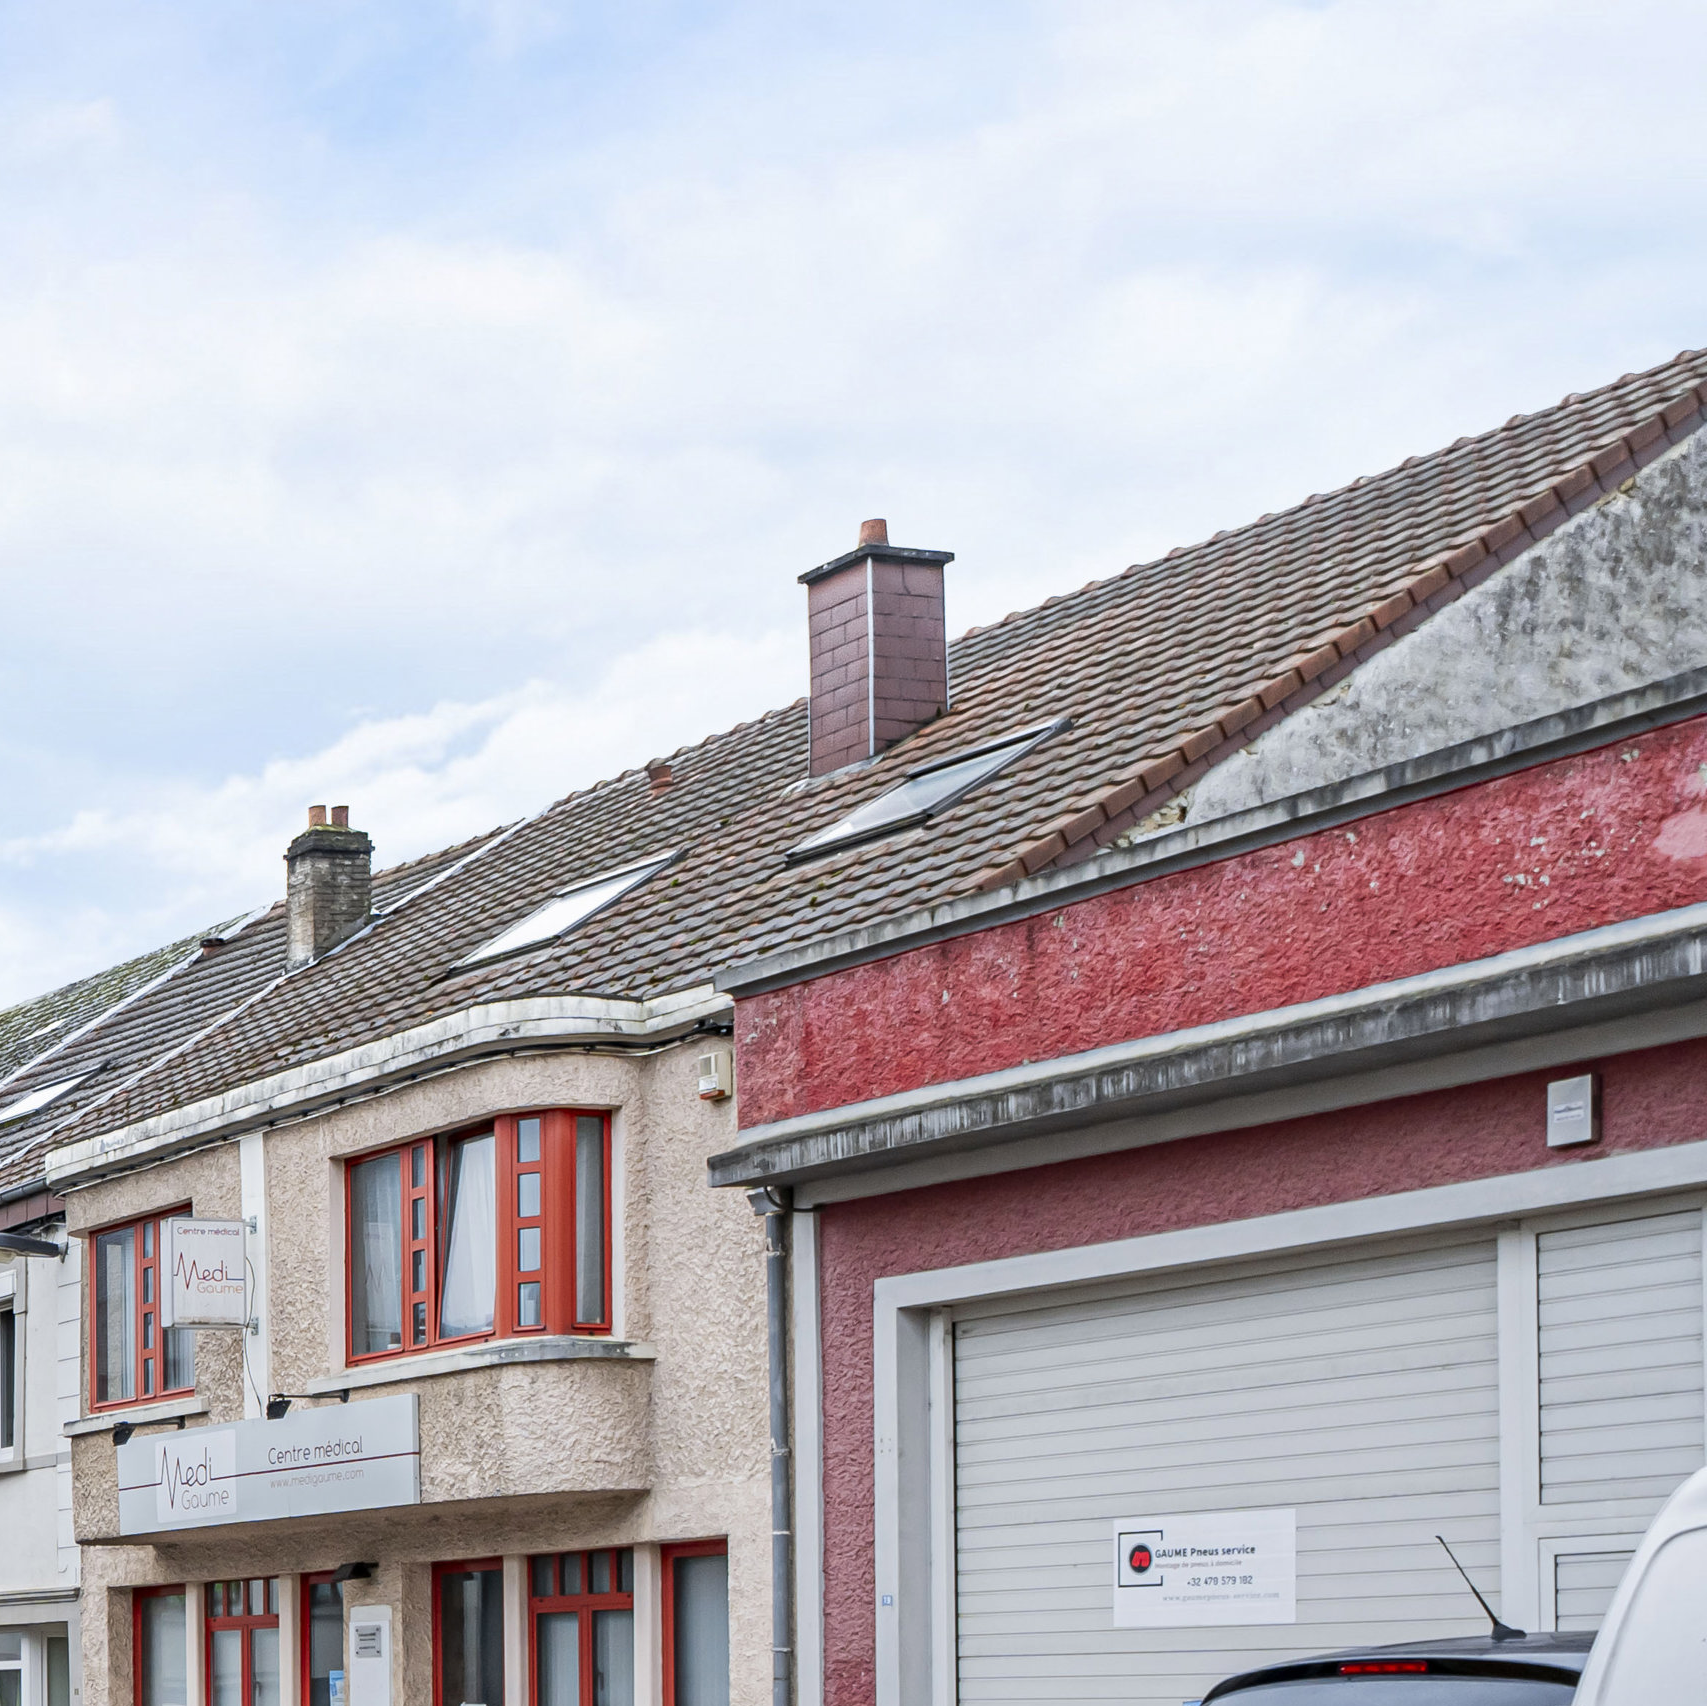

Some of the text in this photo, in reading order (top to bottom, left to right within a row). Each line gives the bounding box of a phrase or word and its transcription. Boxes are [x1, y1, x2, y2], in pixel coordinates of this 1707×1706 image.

[177, 1227, 240, 1236] Centre médical
[175, 1252, 228, 1291] Medi
[197, 1281, 244, 1294] Gaume
[268, 1435, 363, 1465] Centre médical
[160, 1446, 213, 1510] Medi
[270, 1469, 364, 1489] www.medigaume.com
[181, 1489, 229, 1510] Gaume
[1155, 1544, 1256, 1559] GAUME Pneus service
[1221, 1575, 1237, 1586] 579
